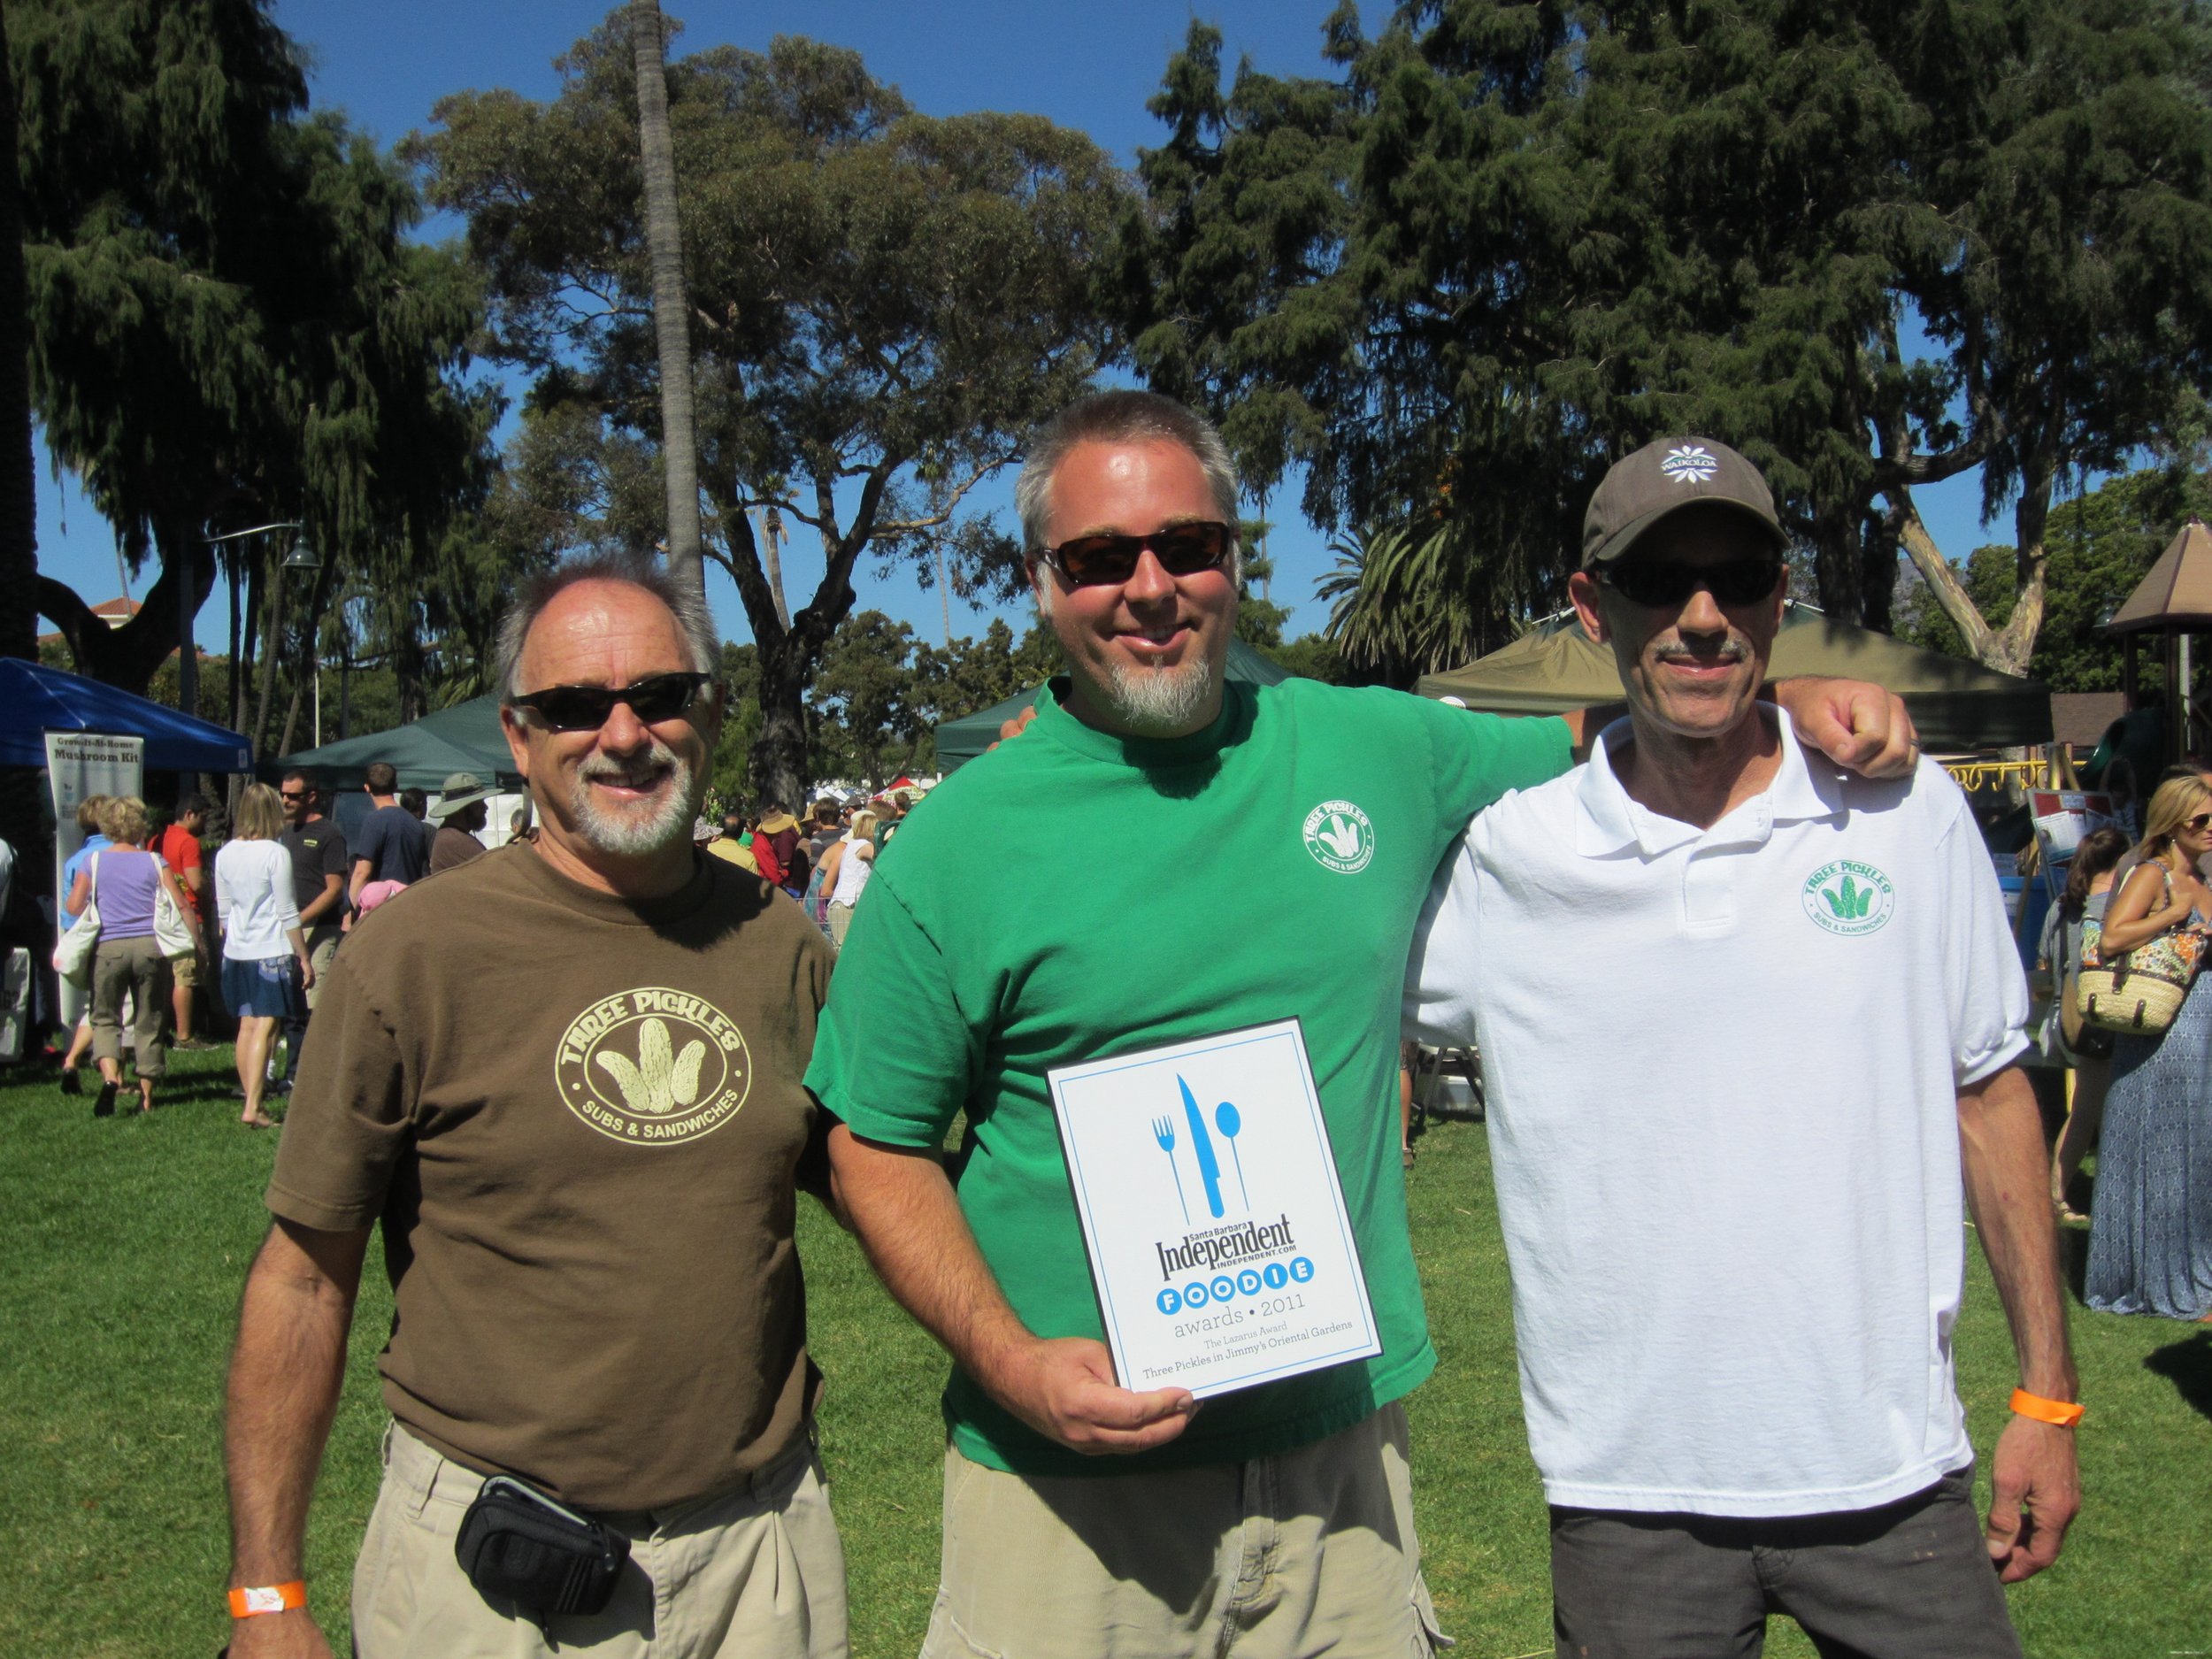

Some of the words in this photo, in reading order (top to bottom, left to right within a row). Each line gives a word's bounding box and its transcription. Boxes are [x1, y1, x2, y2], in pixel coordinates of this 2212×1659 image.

[1661, 459, 1718, 471] WAIKOLOA
[54, 749, 119, 763] Mushroom
[120, 753, 139, 764] Kit
[1304, 809, 1325, 843] THREE
[1323, 803, 1369, 826] PICKLES
[1805, 864, 1838, 895] THREE
[1840, 862, 1892, 894] PICKLES
[1813, 911, 1832, 928] SUBS
[1840, 912, 1887, 933] SANDWICHES
[560, 996, 629, 1065] THREE
[633, 990, 741, 1051] PICKLES
[582, 1100, 625, 1133] SUBS
[626, 1122, 639, 1137] &
[643, 1088, 739, 1139] SANDWICHES
[1155, 1213, 1294, 1282] Independent
[1189, 1230, 1214, 1242] Santa
[1214, 1221, 1248, 1236] Barbara
[1217, 1244, 1297, 1270] INDEPENDENT.COM
[1161, 1260, 1310, 1311] FOODIE
[1174, 1305, 1244, 1339] awards
[1261, 1294, 1305, 1317] 2011
[1203, 1338, 1222, 1349] The
[1223, 1331, 1258, 1346] Lazarus
[1259, 1320, 1287, 1337] Award
[1142, 1363, 1174, 1379] Three
[1175, 1353, 1212, 1372] Pickles
[1213, 1350, 1224, 1363] in
[1225, 1340, 1267, 1360] Jimmy's
[1268, 1331, 1310, 1348] Oriental
[1310, 1319, 1353, 1339] Gardens
